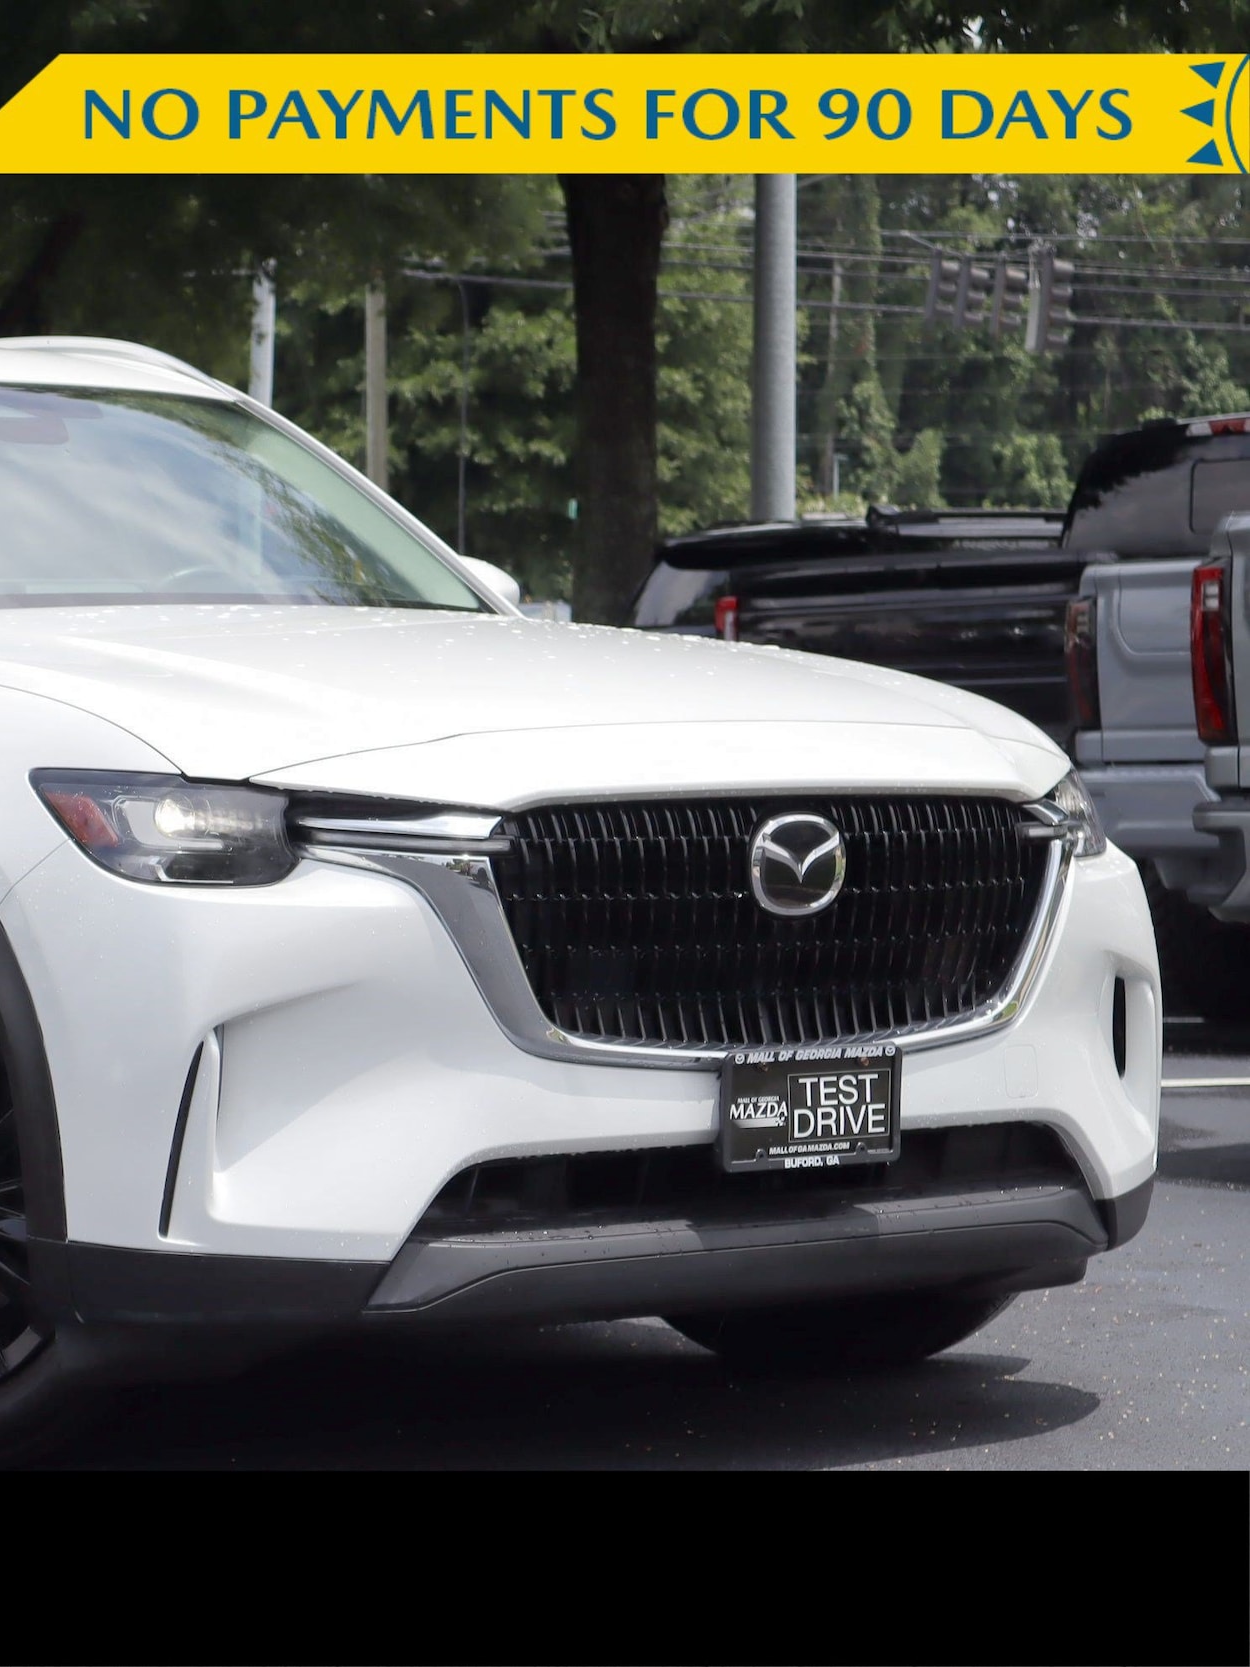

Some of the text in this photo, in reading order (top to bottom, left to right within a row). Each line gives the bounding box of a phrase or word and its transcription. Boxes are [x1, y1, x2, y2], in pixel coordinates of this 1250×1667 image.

[746, 1046, 882, 1064] MALL OF GEORGIA MAZDA
[798, 1073, 878, 1107] TEST
[729, 1100, 788, 1120] MAZDA
[793, 1103, 886, 1139] DRIVE
[784, 1155, 840, 1169] BUFORD, GA
